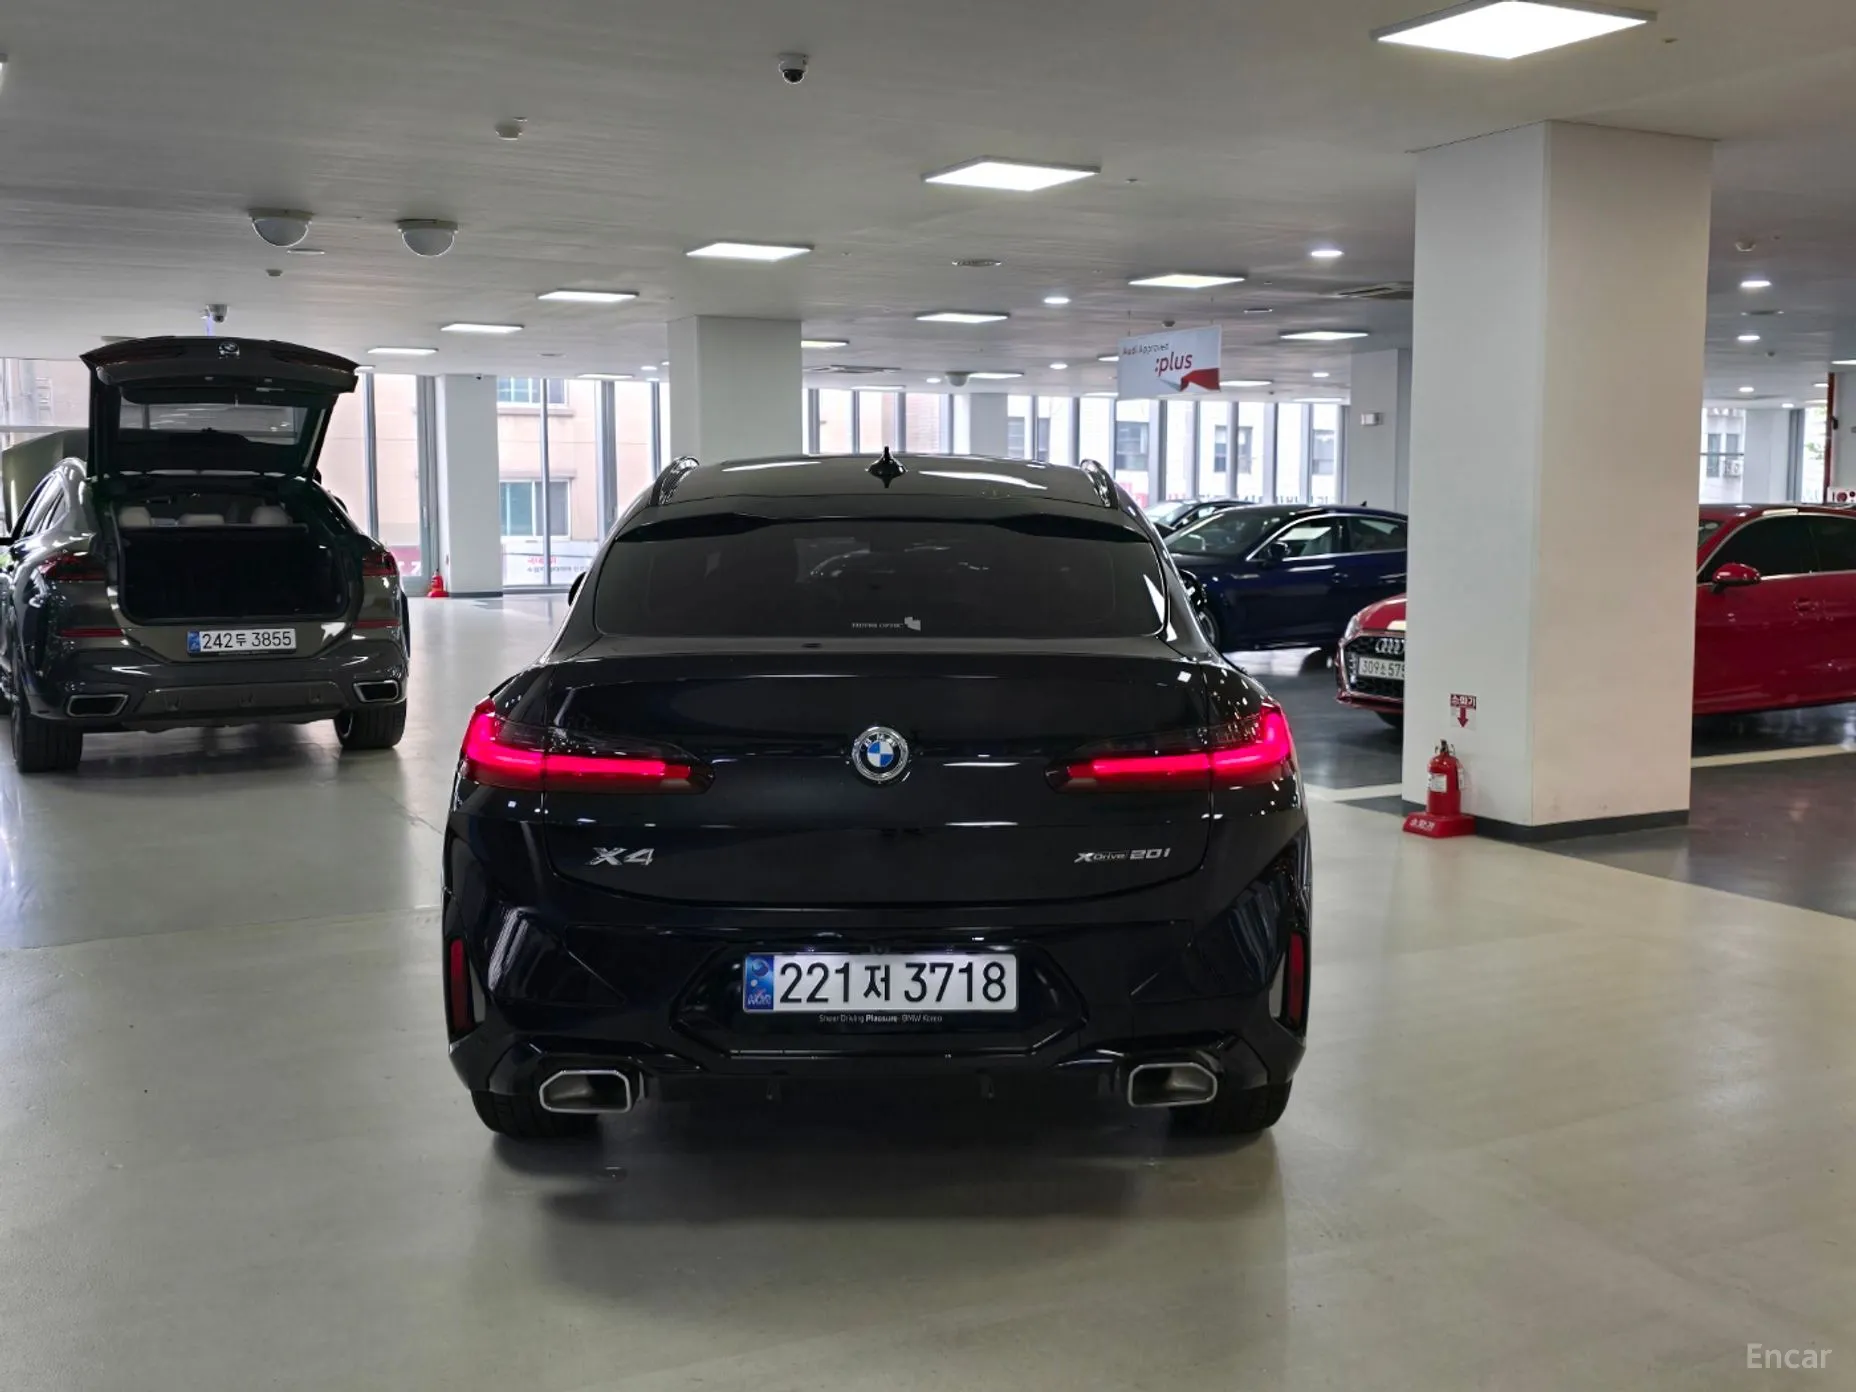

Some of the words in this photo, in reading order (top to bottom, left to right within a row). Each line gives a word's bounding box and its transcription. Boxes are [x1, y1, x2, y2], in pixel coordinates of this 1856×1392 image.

[251, 631, 292, 647] 3855
[586, 846, 655, 866] X4
[904, 961, 1006, 1002] 3718
